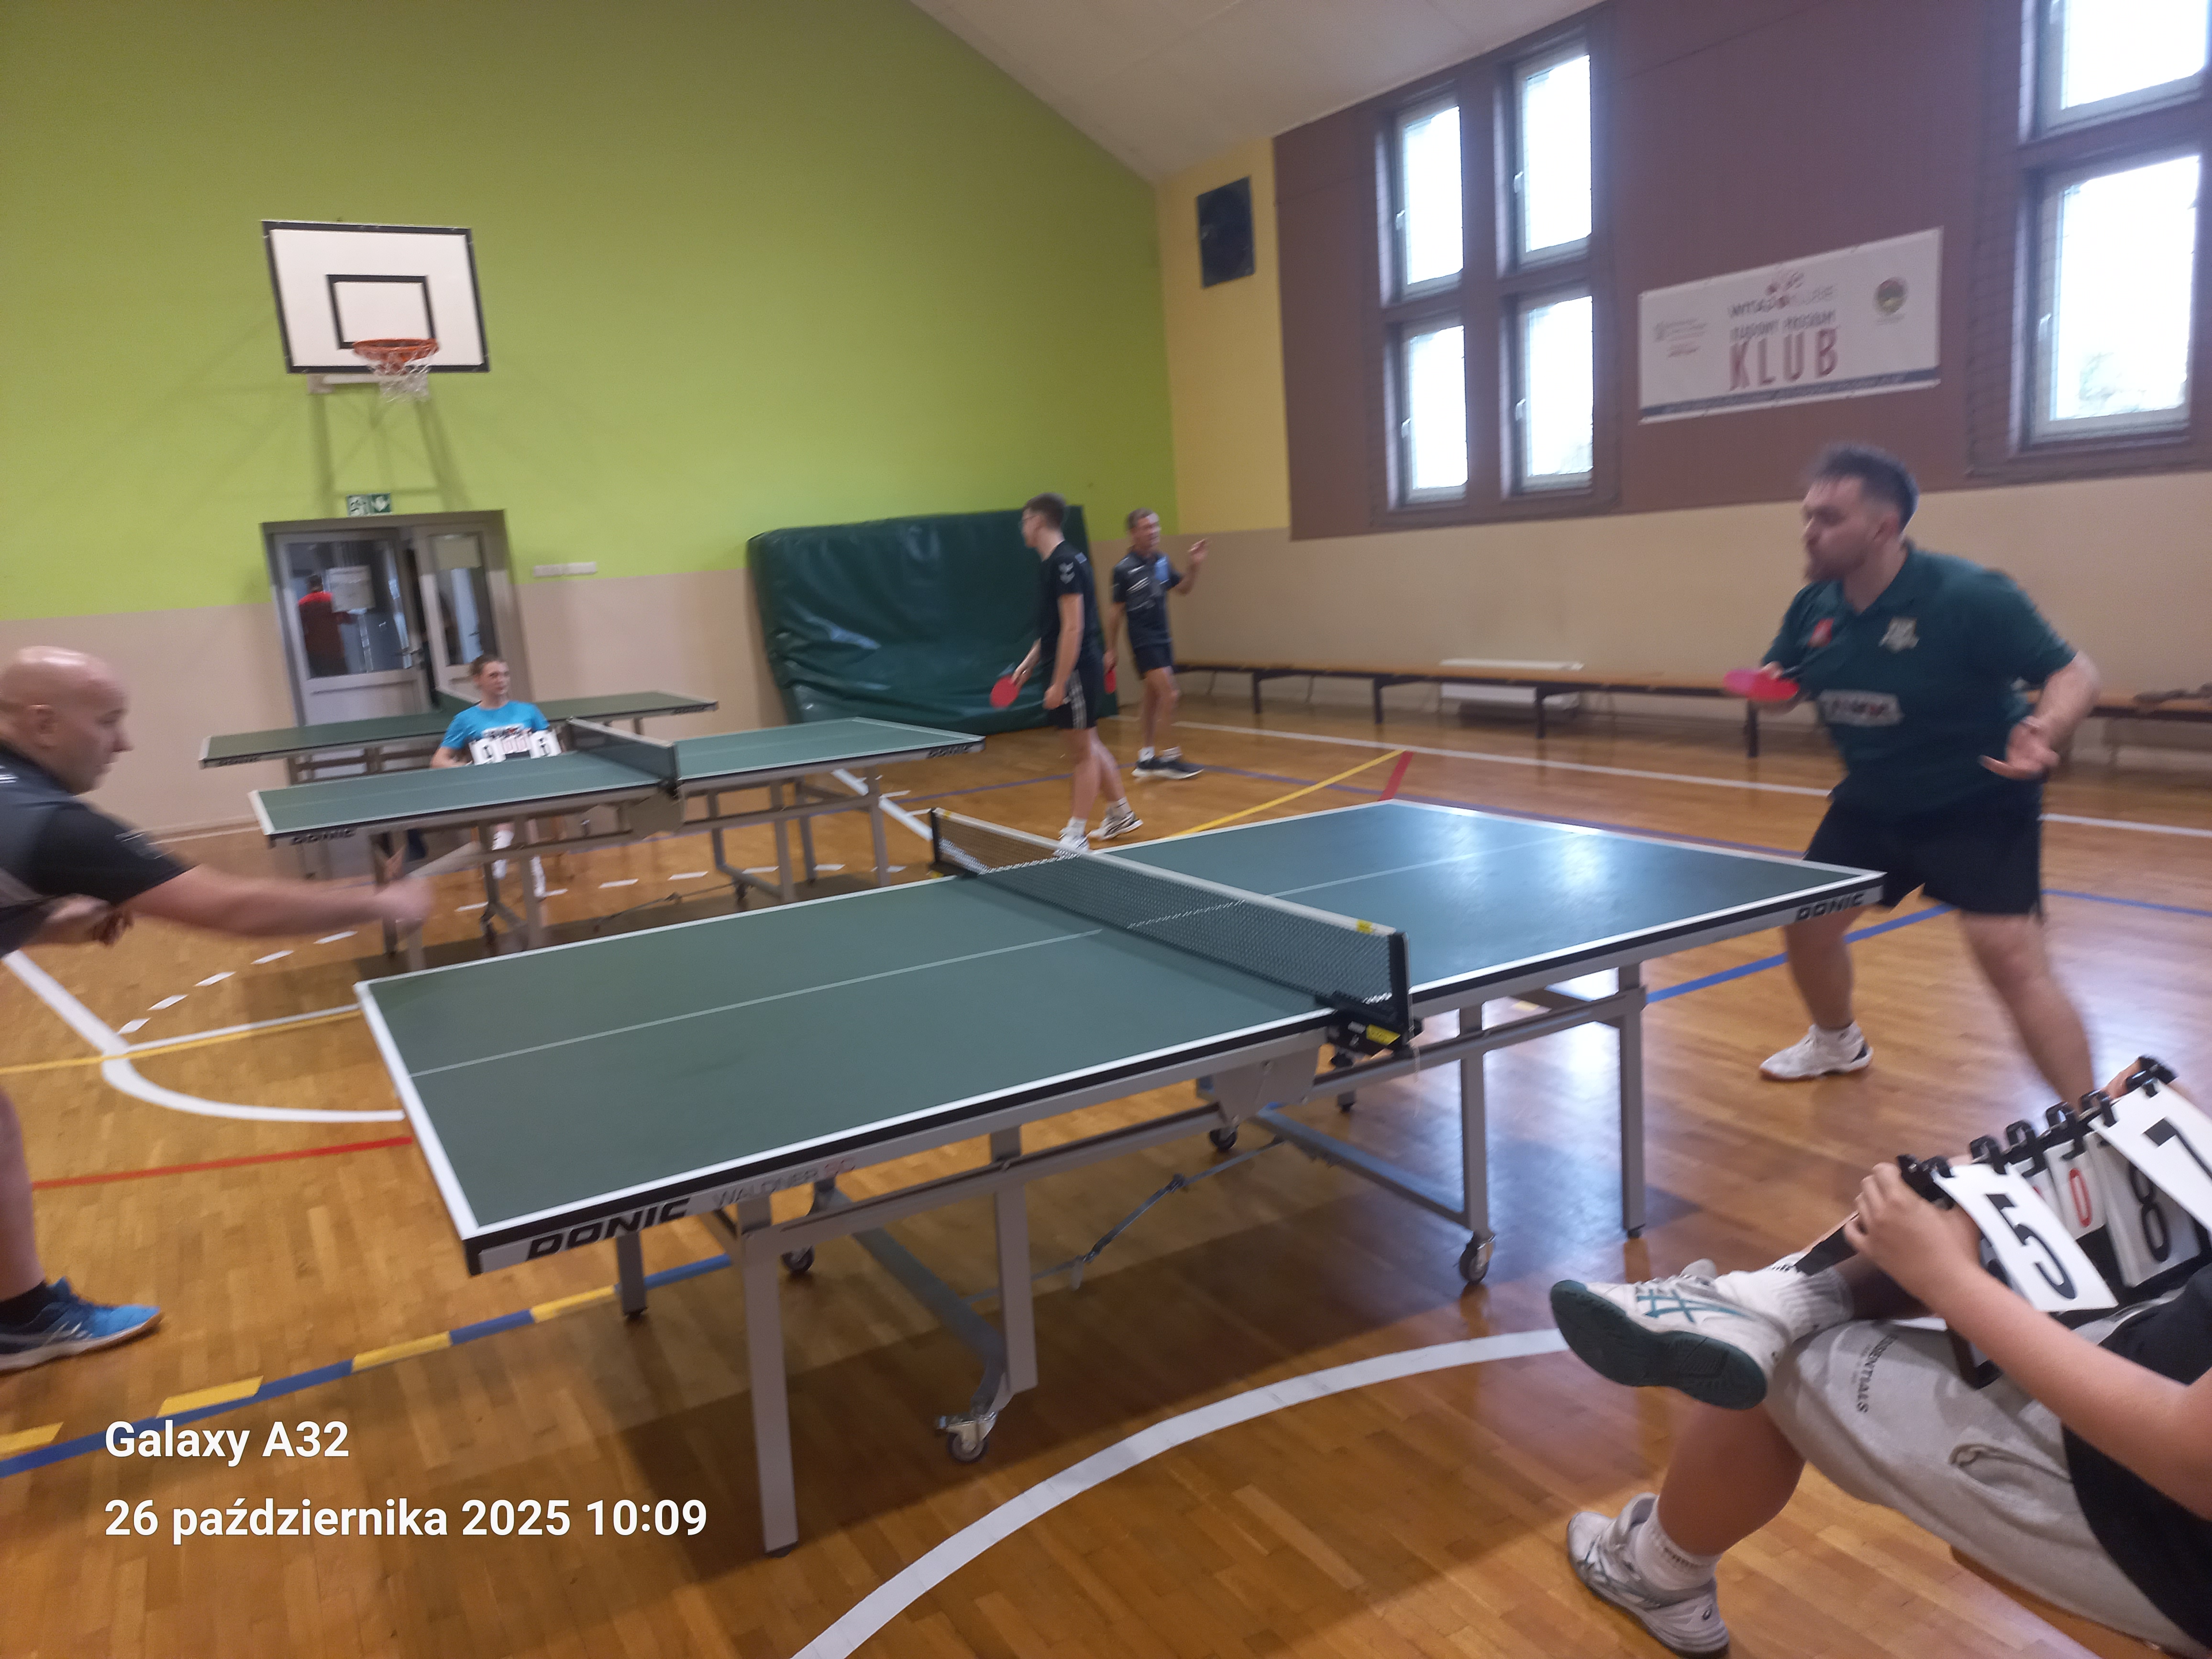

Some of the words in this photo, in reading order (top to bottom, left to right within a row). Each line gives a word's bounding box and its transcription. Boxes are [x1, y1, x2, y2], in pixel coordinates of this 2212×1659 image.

[1728, 327, 1838, 390] KLUB
[1795, 892, 1864, 922] DONIC
[526, 1197, 690, 1261] DONIC
[1985, 1193, 2079, 1300] 5
[2069, 1168, 2092, 1228] 0
[2128, 1161, 2171, 1263] 8
